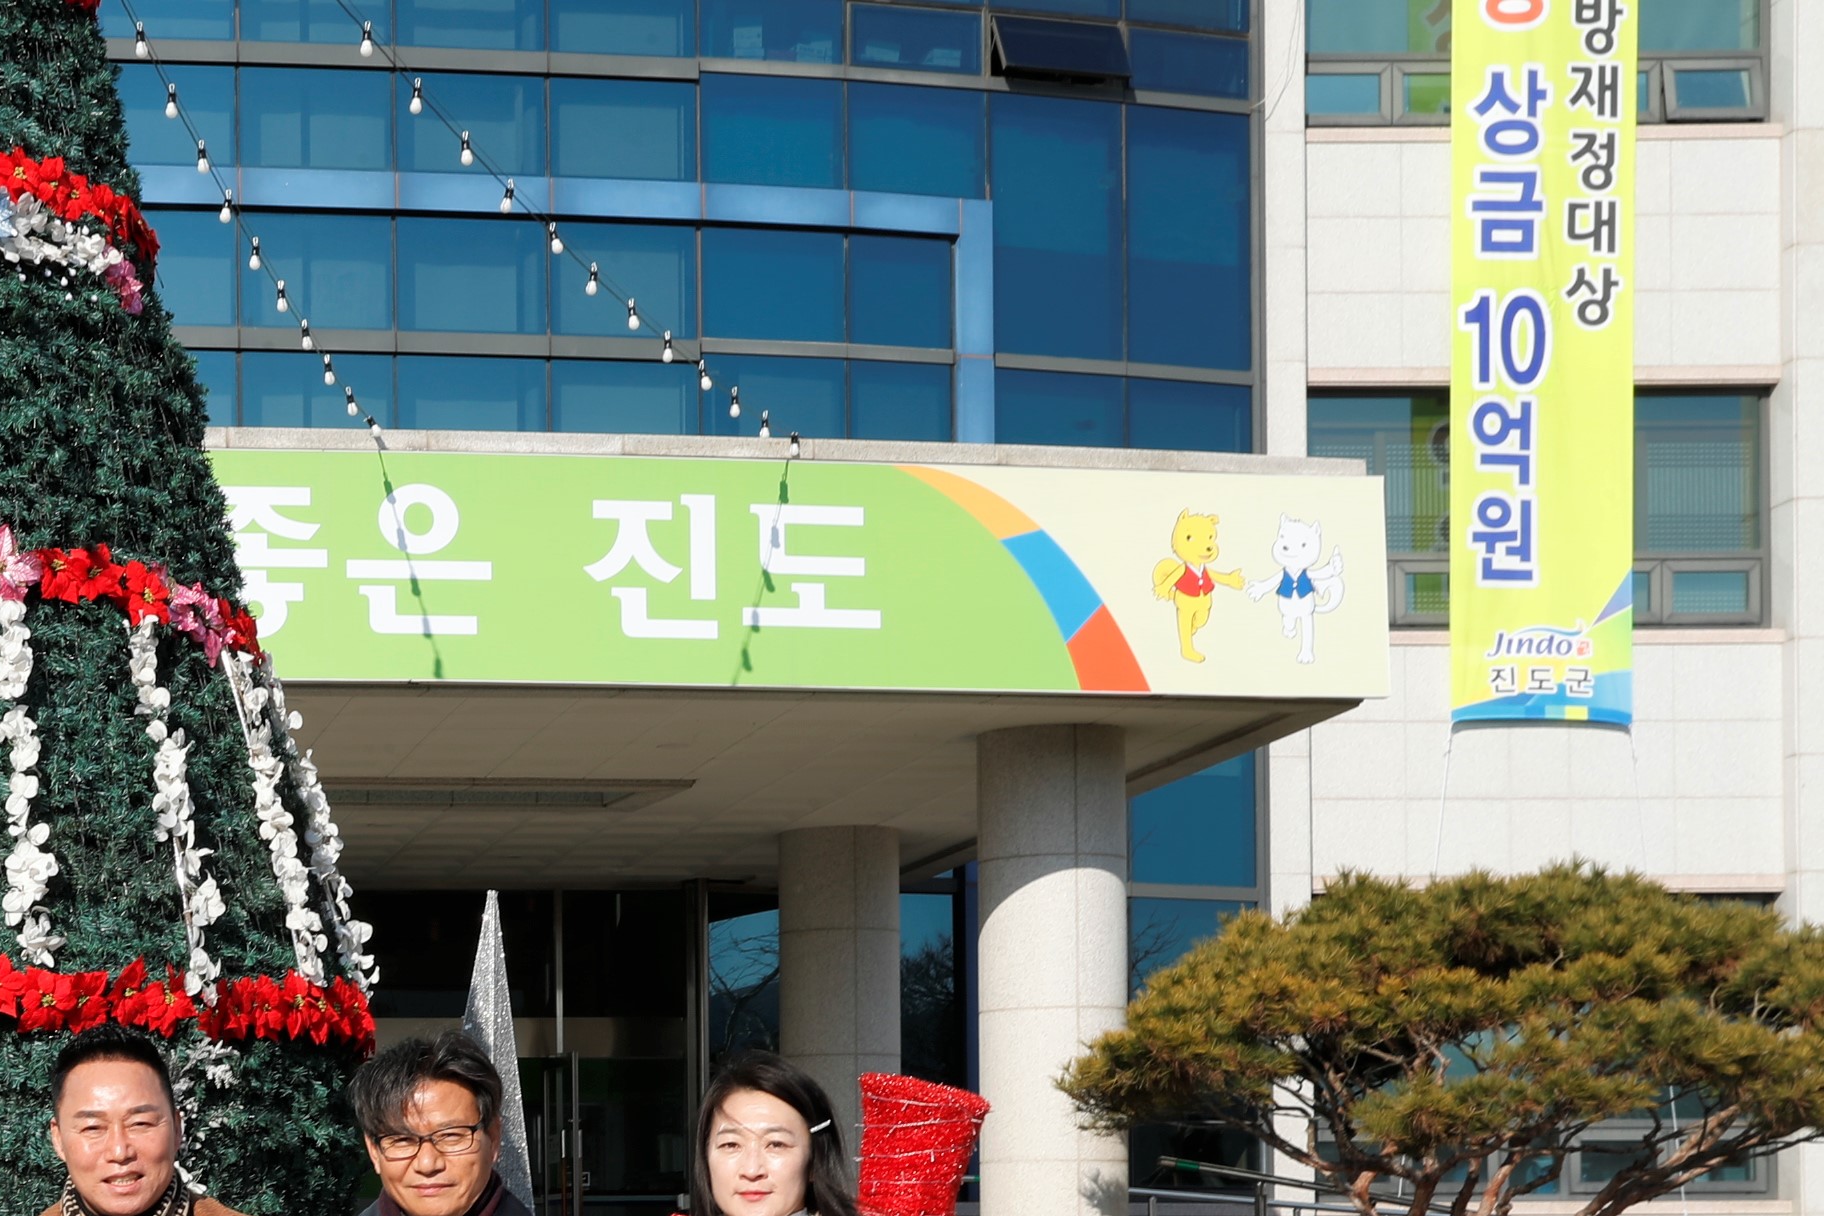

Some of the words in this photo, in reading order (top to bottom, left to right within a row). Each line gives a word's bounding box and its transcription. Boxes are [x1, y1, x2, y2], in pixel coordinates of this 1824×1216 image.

[1473, 69, 1548, 253] 상금
[220, 482, 492, 640] 좋은
[583, 492, 883, 641] 진도
[1486, 632, 1573, 657] Jindo
